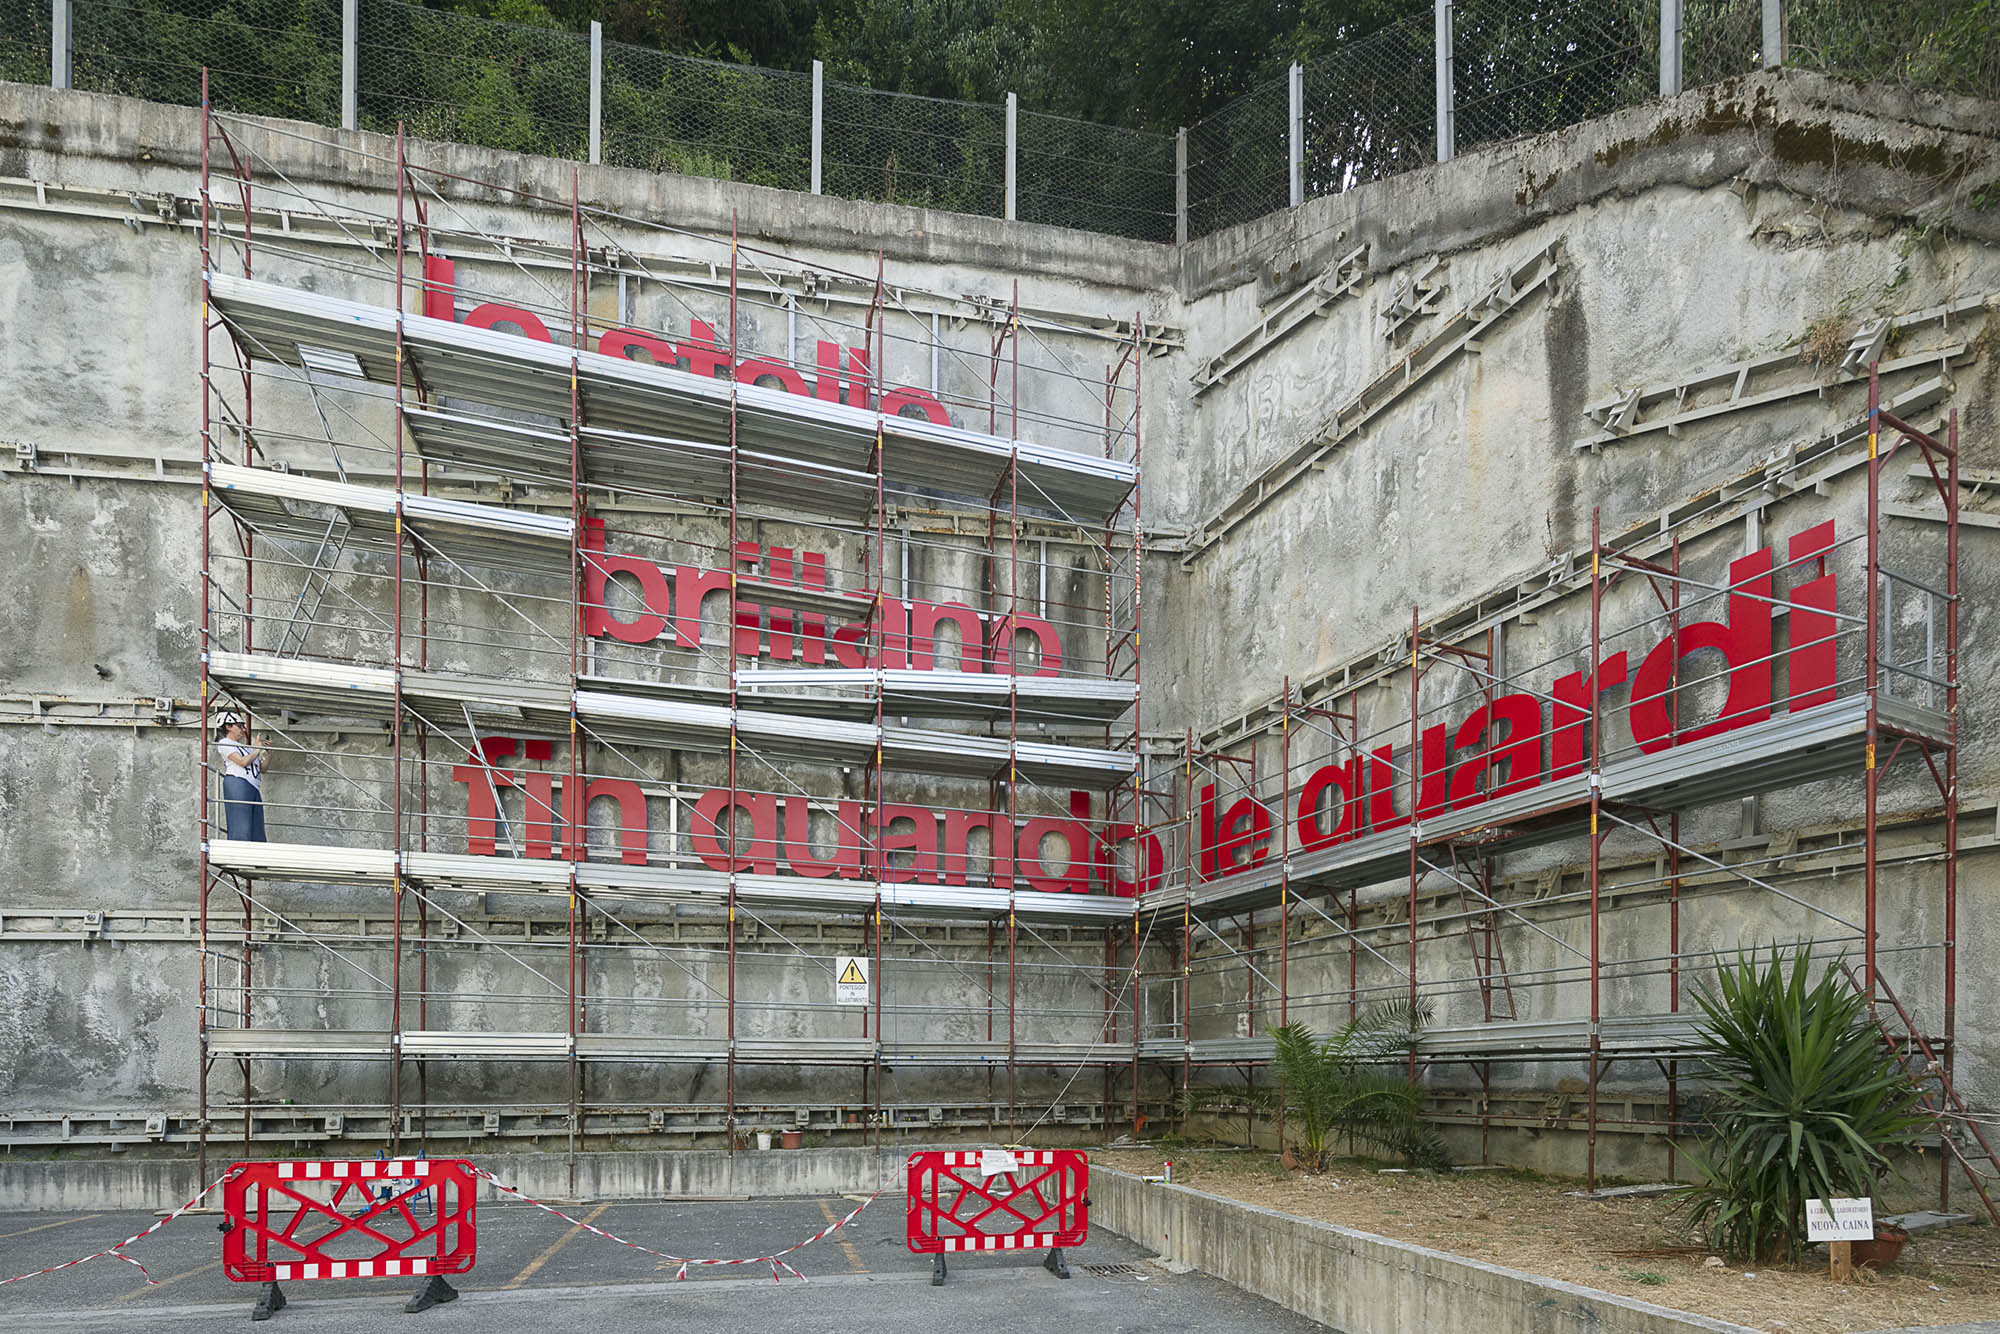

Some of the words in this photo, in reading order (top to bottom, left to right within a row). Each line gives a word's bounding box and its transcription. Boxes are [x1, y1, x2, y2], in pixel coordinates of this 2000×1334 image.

[578, 515, 1063, 678] brillano
[452, 736, 648, 866] fin
[690, 787, 1164, 898] quando
[1200, 784, 1271, 883] le
[1811, 1220, 1840, 1231] NUOVA
[1842, 1219, 1869, 1230] CAINA
